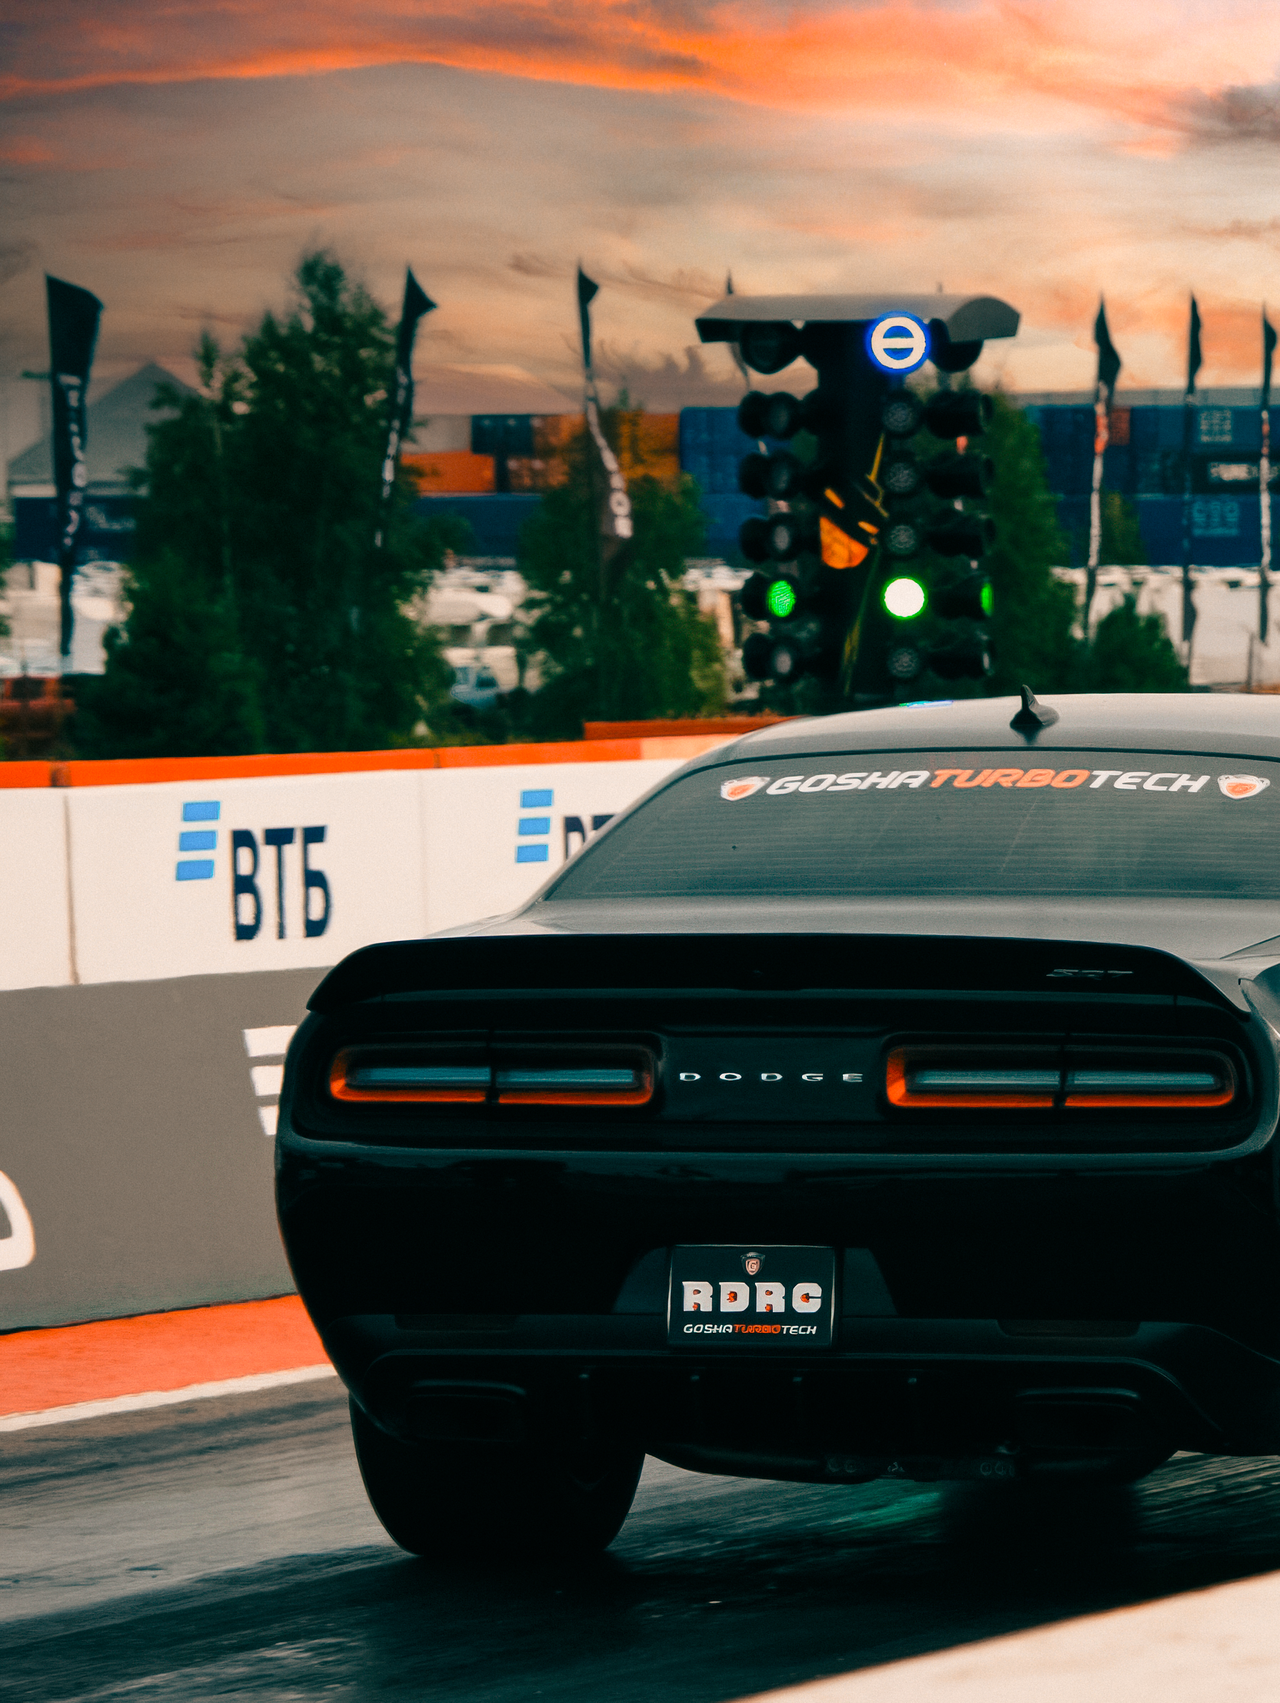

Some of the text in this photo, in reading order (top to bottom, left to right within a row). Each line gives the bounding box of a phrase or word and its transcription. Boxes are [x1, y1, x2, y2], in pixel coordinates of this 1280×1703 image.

[765, 768, 1210, 795] GOSHATURBOTECH
[231, 825, 332, 941] ВТБ
[679, 1072, 864, 1083] DODGE
[681, 1280, 822, 1314] RDRC
[683, 1323, 817, 1336] GOSHATURBOTECH
